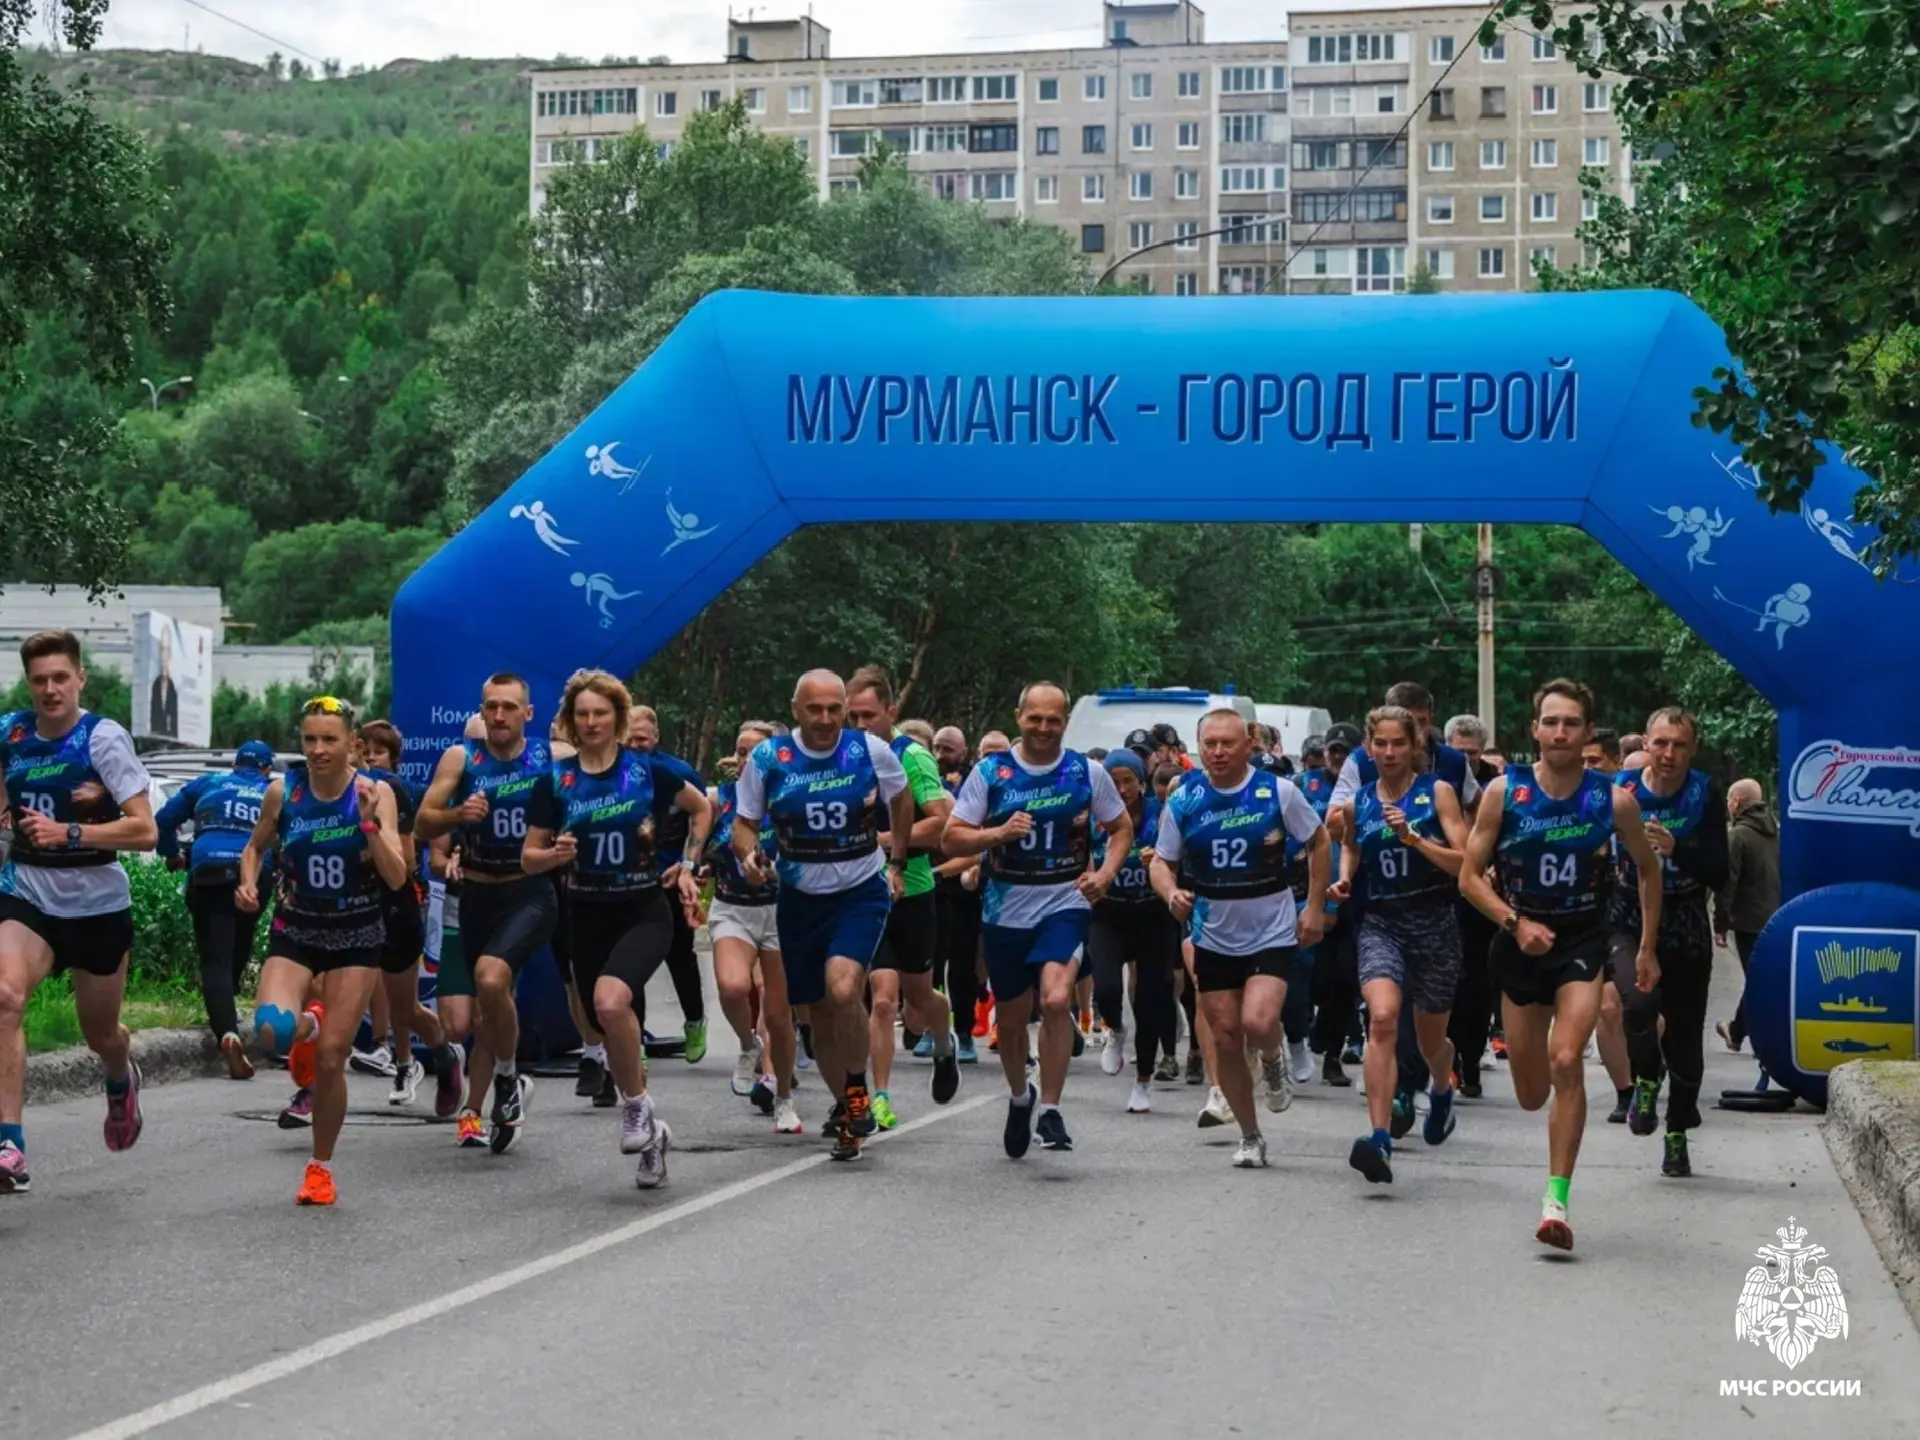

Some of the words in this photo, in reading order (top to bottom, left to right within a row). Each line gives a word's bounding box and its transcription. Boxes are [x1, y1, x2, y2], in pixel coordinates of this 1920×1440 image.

[787, 374, 1120, 445] МУРМАНСК
[1177, 372, 1373, 452] ГОРОД
[1391, 356, 1580, 444] ГЕРОЙ
[397, 763, 432, 781] орту
[808, 773, 856, 793] БЕЖИТ
[590, 799, 636, 824] БЕЖИТ
[805, 800, 849, 831] 53
[1025, 792, 1072, 811] БЕЖИТ
[311, 824, 358, 843] БЕЖИТ
[492, 806, 527, 839] 66
[1220, 812, 1264, 831] БЕЖИТ
[1544, 822, 1594, 843] БЕЖИТ
[588, 831, 625, 866] 70
[1211, 837, 1248, 868] 52
[1379, 847, 1408, 879] 67
[307, 854, 346, 890] 68
[1538, 852, 1578, 888] 64
